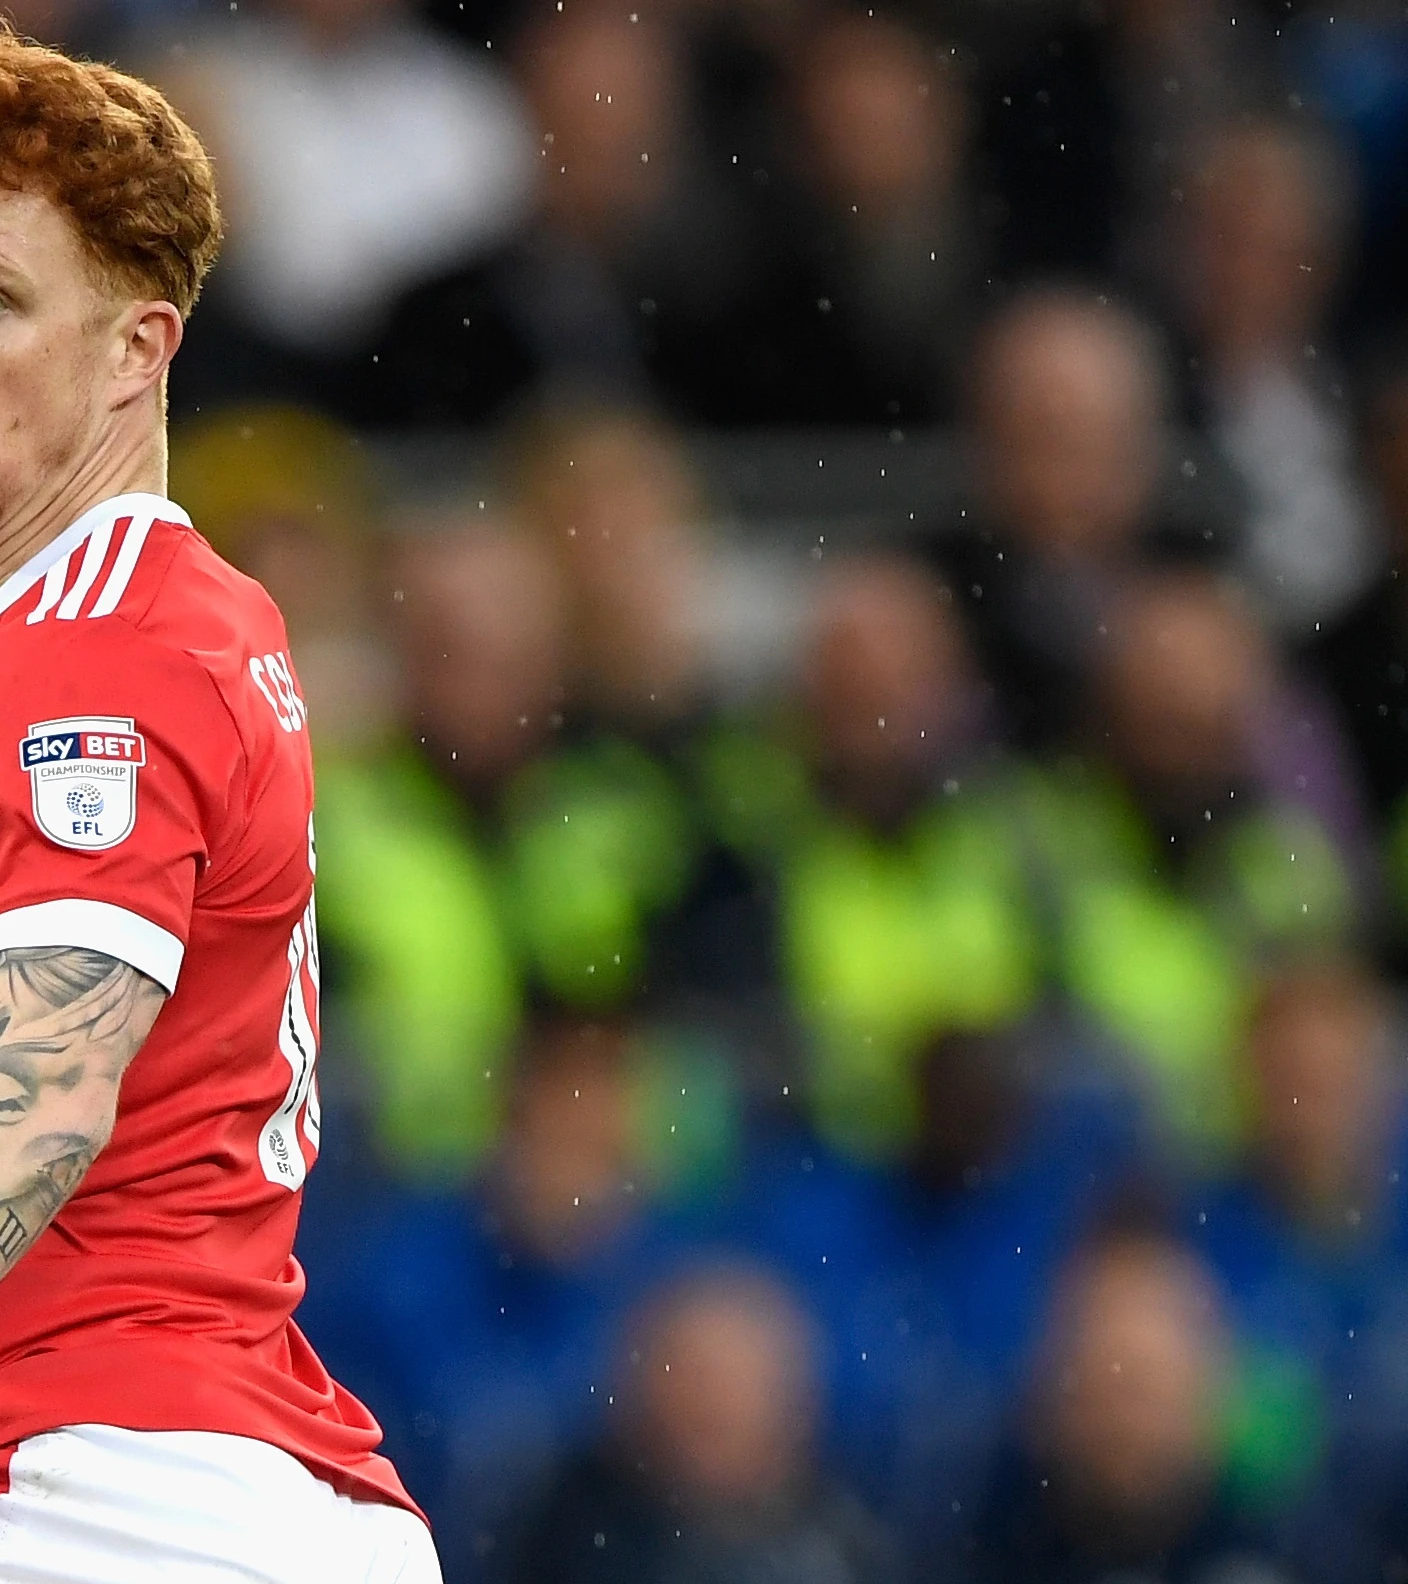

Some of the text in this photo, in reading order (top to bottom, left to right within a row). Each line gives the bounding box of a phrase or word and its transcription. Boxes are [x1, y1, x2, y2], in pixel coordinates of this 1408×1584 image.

[27, 736, 136, 761] sky BET
[41, 764, 126, 777] CHAMPIONSHIP
[72, 821, 103, 836] EFL
[277, 1161, 294, 1177] EFL
